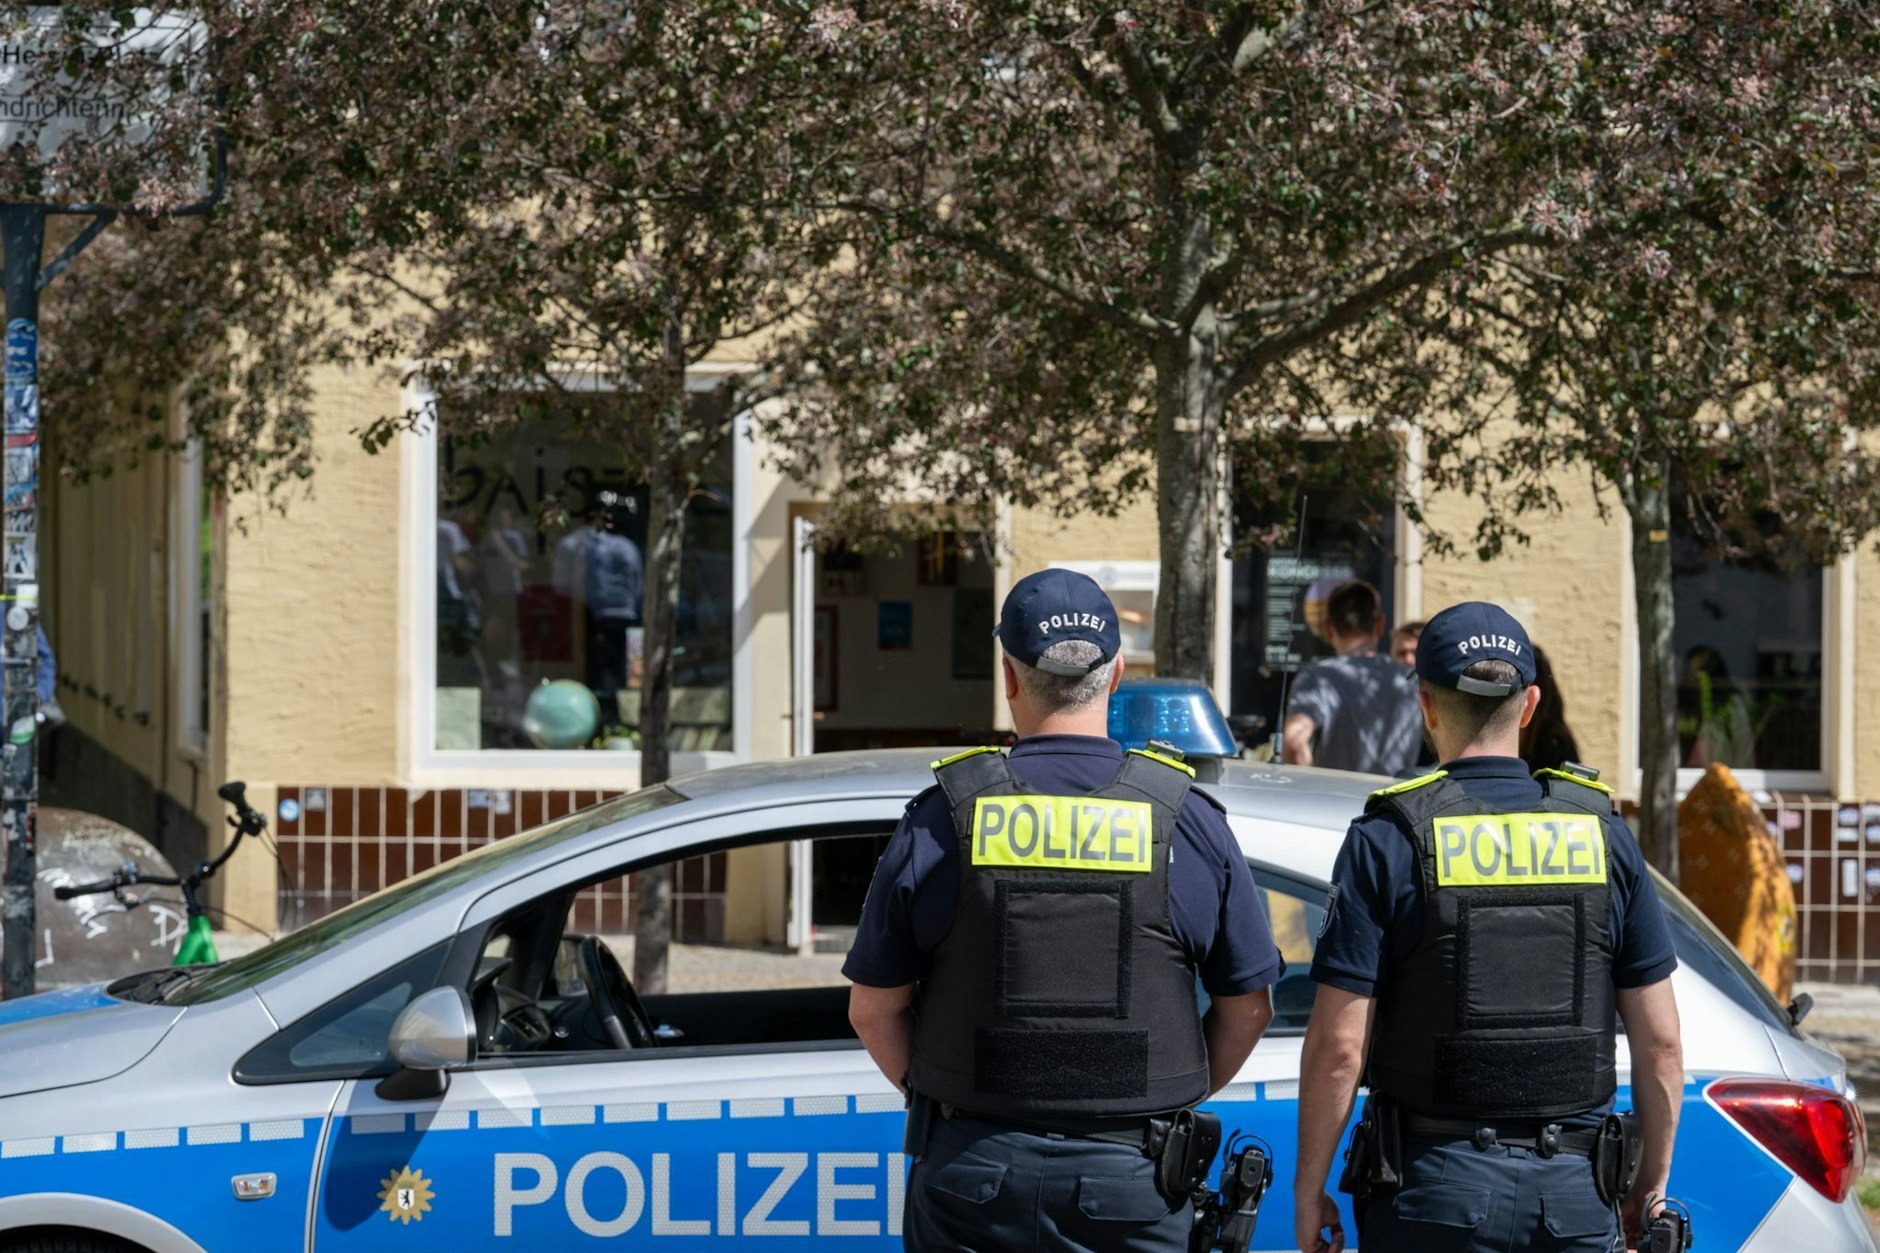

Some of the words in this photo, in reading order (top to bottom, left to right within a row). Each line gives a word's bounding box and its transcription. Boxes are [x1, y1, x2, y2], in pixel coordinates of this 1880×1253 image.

[1037, 612, 1107, 635] POLIZEI
[1457, 633, 1522, 656] POLIZEI
[977, 803, 1146, 864] POLIZEI
[1439, 821, 1602, 879] POLIZEI
[494, 1151, 904, 1237] POLIZEI
